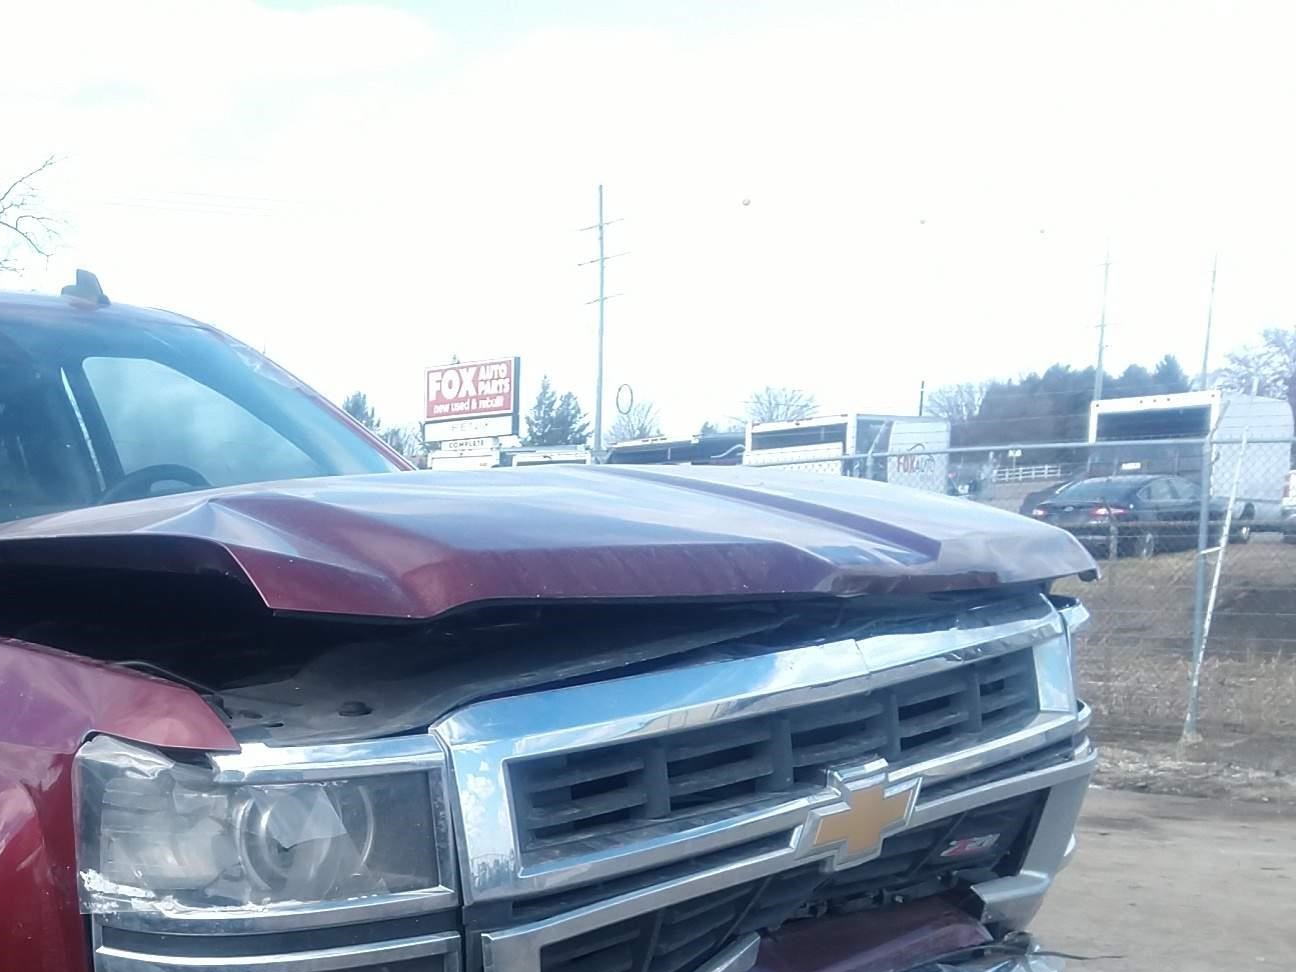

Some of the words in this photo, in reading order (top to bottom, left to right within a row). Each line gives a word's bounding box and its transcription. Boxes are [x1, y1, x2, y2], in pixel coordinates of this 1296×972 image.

[479, 363, 508, 381] AUTO
[428, 366, 477, 402] FOX
[478, 377, 510, 397] PARTS
[433, 403, 450, 415] new
[451, 398, 470, 412] used
